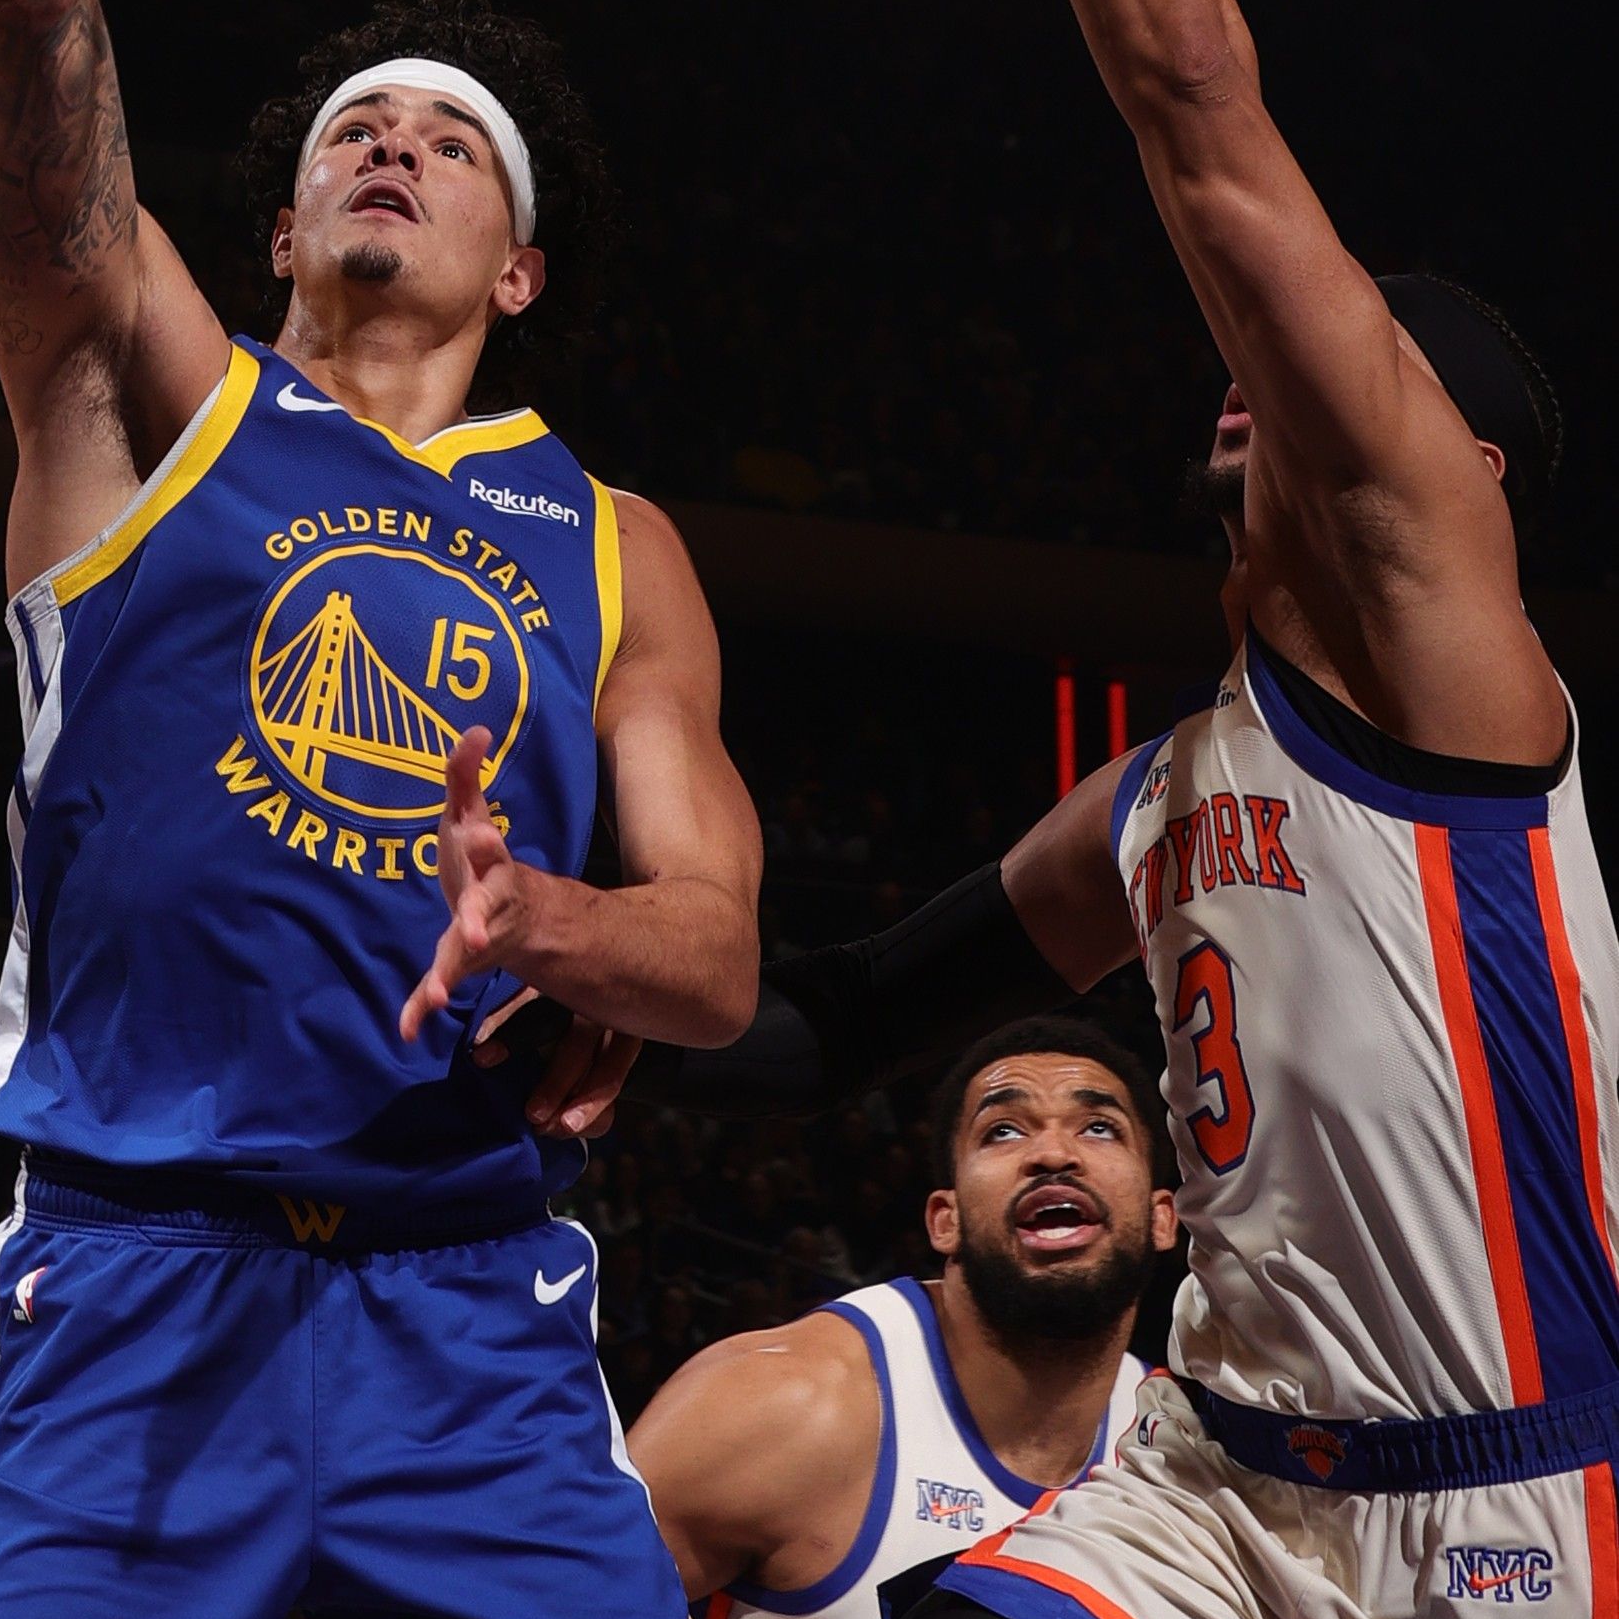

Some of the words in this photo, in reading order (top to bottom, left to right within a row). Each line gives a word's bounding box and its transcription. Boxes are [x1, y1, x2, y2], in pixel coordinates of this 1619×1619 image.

[469, 478, 579, 527] Rakuten
[264, 506, 432, 561] GOLDEN
[447, 527, 550, 634] STATE
[424, 617, 496, 701] 15
[1165, 792, 1306, 906] YORK
[1172, 938, 1255, 1176] 3
[916, 1478, 984, 1532] NYC
[1446, 1546, 1553, 1603] NYC
